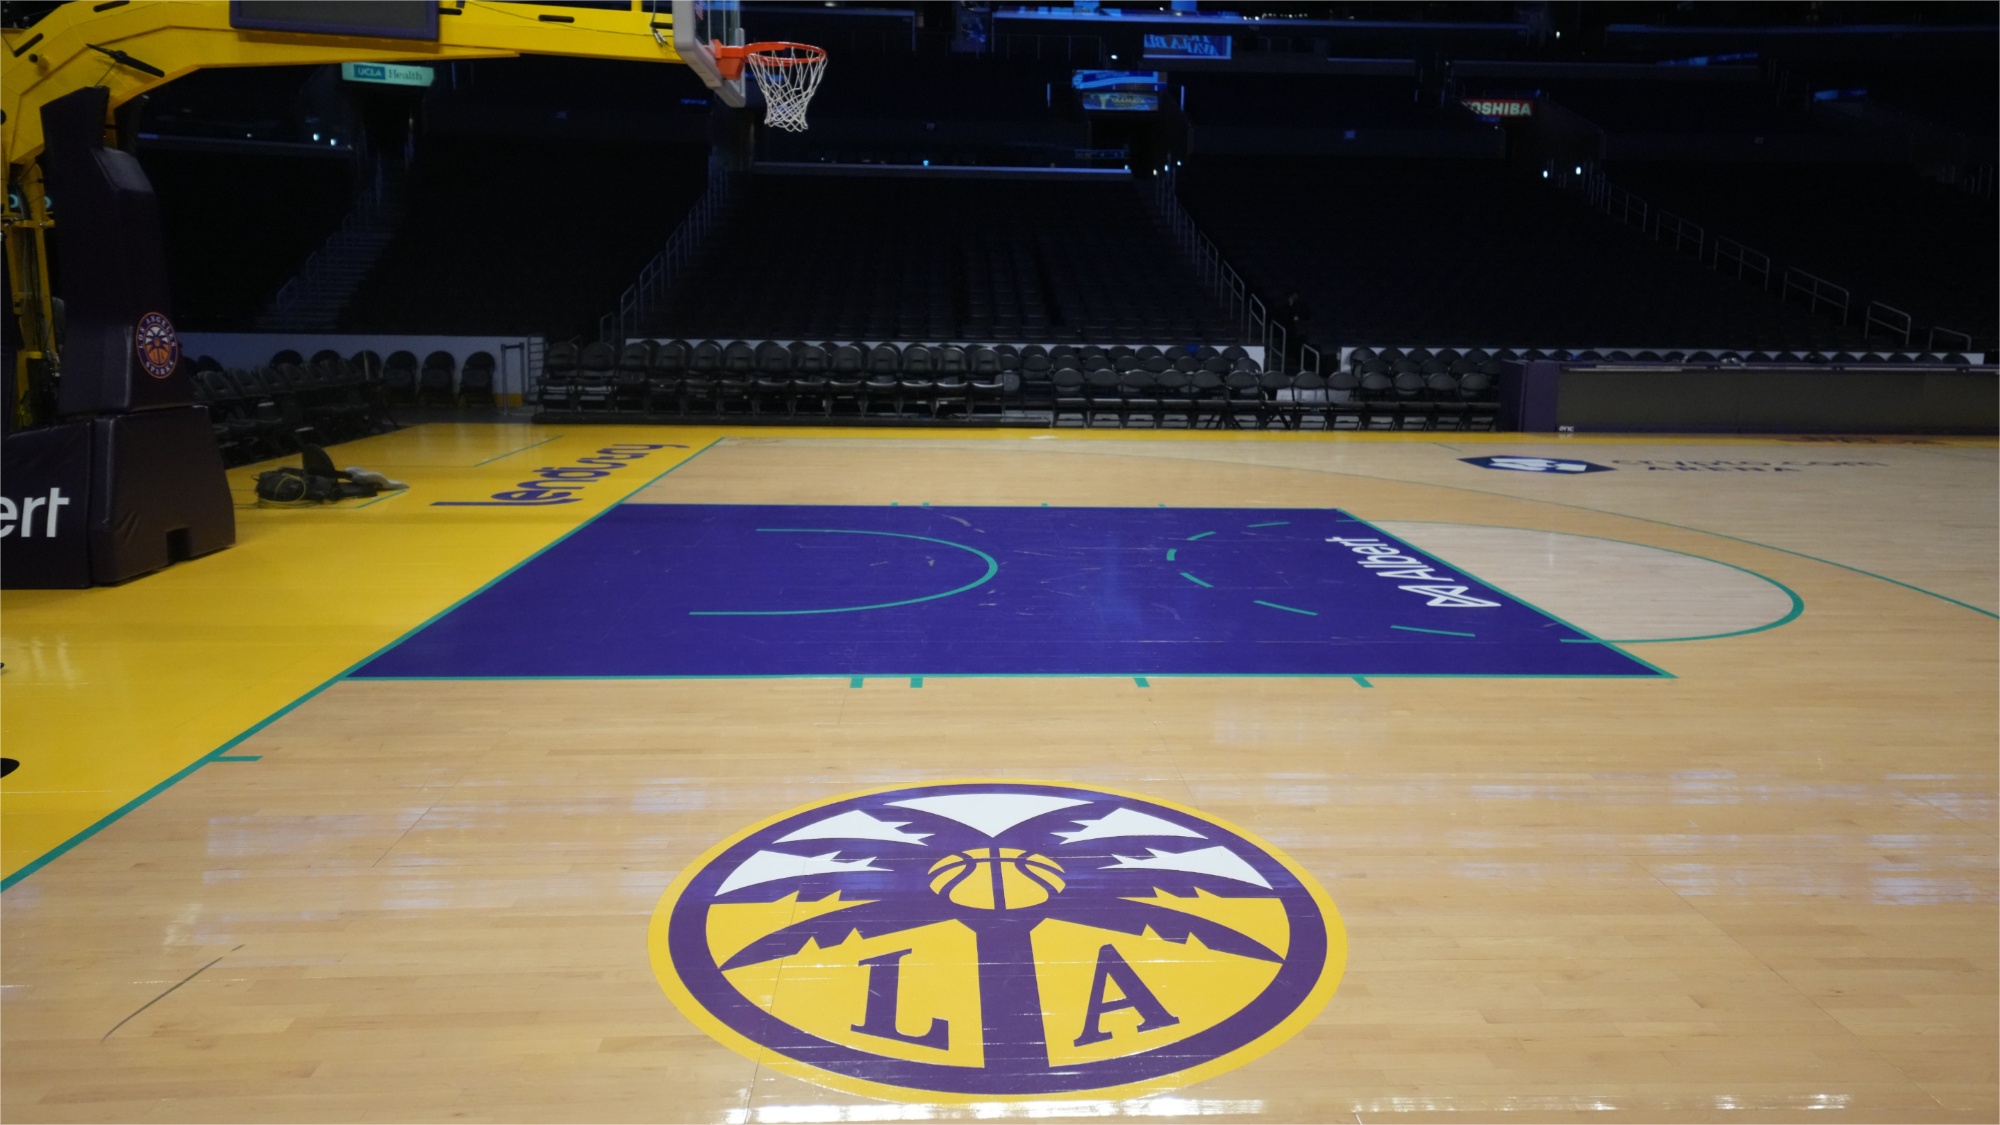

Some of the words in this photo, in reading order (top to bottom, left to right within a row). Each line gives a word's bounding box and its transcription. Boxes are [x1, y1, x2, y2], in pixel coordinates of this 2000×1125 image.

[357, 66, 383, 77] UCLA
[388, 69, 423, 80] Health
[1462, 101, 1532, 116] OSHIBA
[1325, 536, 1455, 582] Albert
